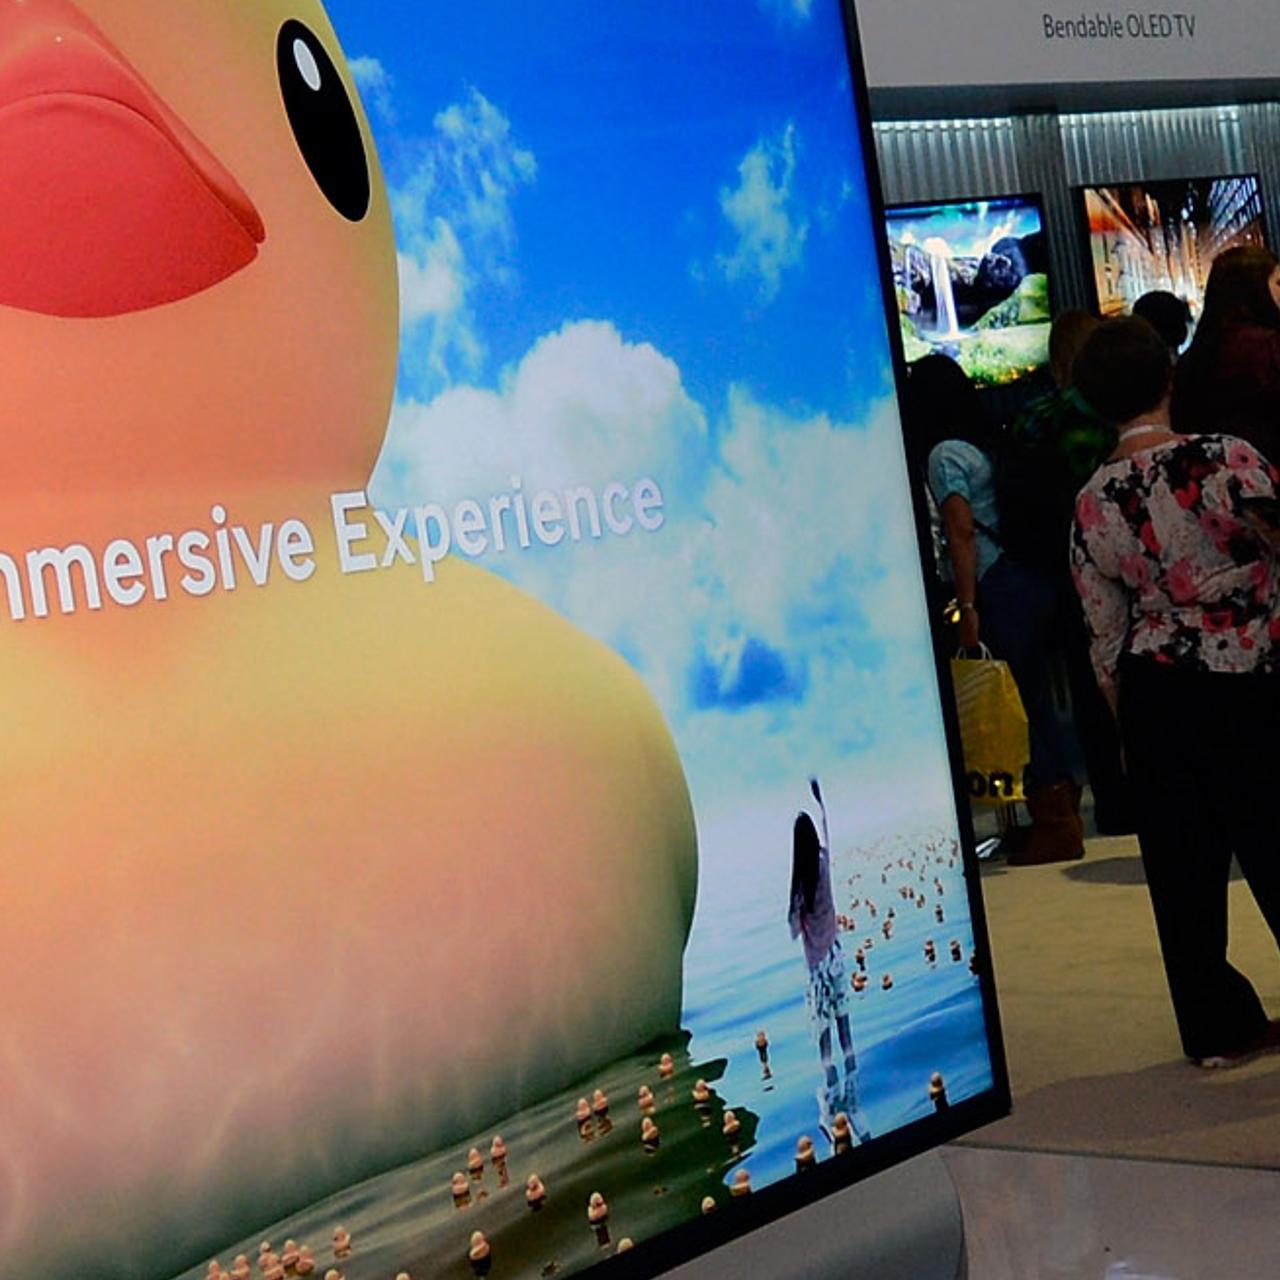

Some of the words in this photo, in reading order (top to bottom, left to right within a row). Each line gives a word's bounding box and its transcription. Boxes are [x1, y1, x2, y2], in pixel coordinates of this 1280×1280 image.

[1042, 12, 1124, 39] Bendable
[1125, 13, 1172, 38] OLED
[1172, 13, 1196, 38] TV
[330, 476, 667, 584] Experience
